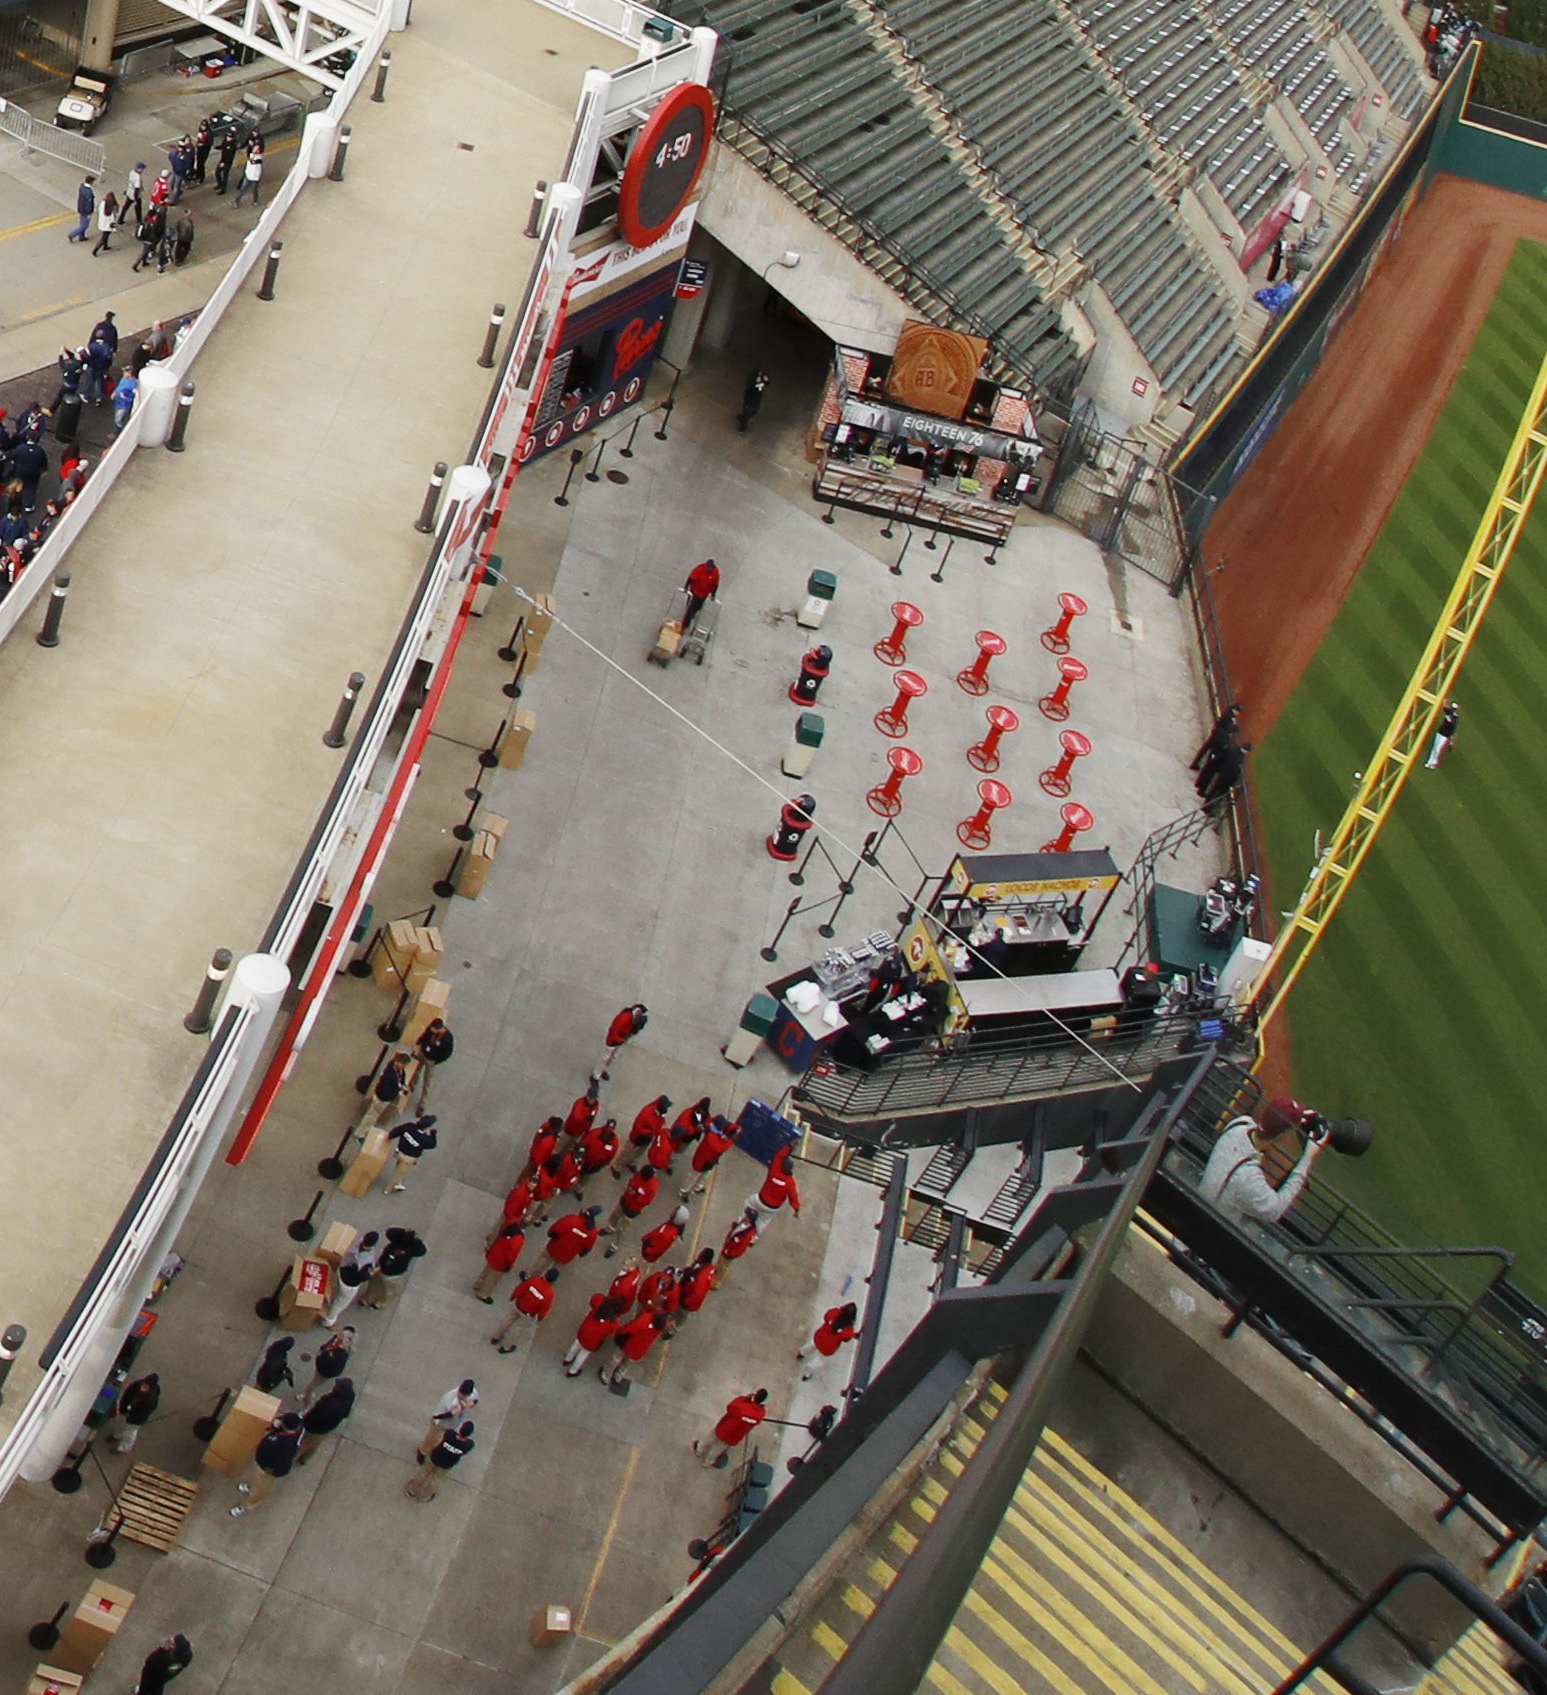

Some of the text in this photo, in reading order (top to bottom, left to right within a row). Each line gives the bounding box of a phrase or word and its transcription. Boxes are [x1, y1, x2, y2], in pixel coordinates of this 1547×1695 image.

[655, 132, 692, 169] 4:50
[902, 415, 985, 448] EIGHTEEN 76
[442, 1441, 463, 1455] STAFF
